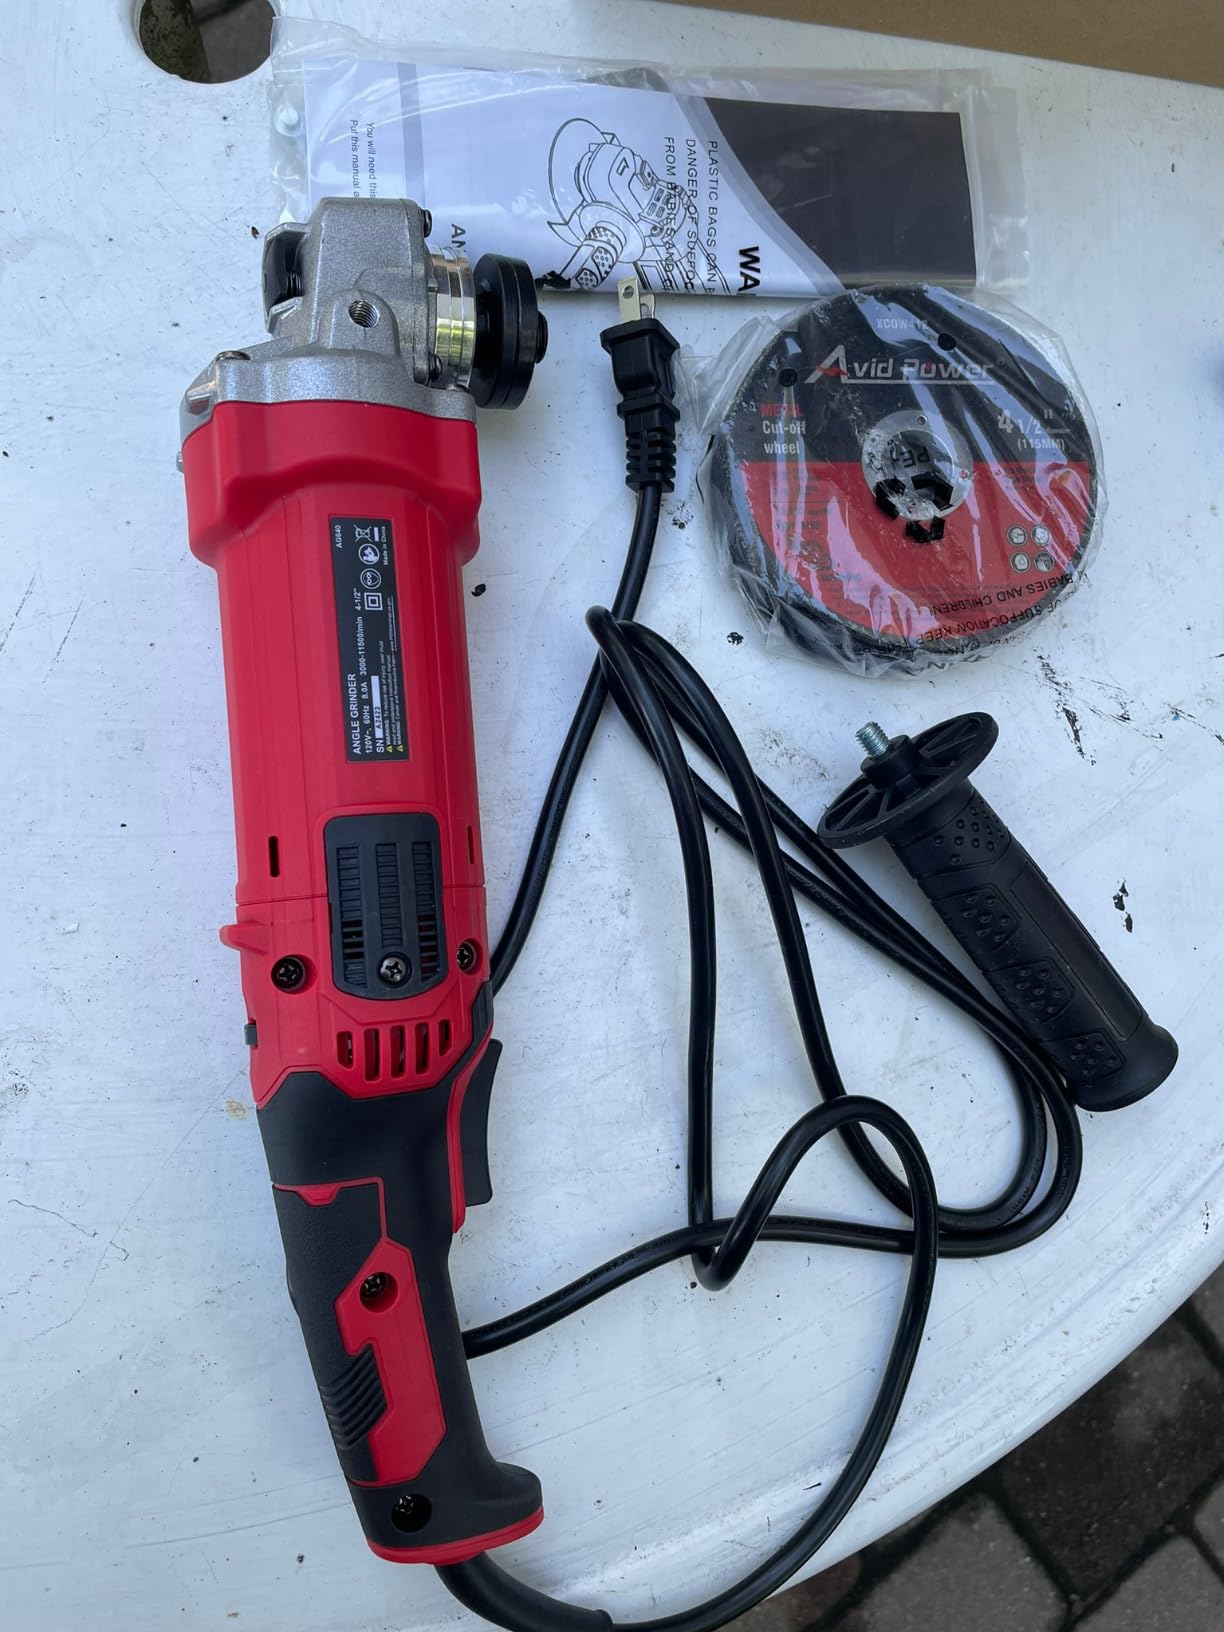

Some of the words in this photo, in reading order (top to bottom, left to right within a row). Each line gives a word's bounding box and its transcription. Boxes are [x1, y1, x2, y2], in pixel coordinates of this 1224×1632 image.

[350, 119, 359, 134] Put
[366, 122, 375, 139] You
[351, 136, 360, 152] this
[367, 140, 377, 155] will
[664, 136, 677, 176] FROM
[352, 154, 361, 188] manual
[368, 156, 377, 181] need
[685, 138, 698, 199] DANGER
[707, 140, 719, 201] PLASTIC
[369, 181, 378, 200] this
[665, 181, 677, 237] BABIES
[687, 204, 698, 224] OF
[706, 206, 718, 248] BAGS
[663, 240, 676, 273] AND
[706, 252, 718, 283] CAN
[804, 344, 894, 384] Avid
[902, 358, 994, 379] Power
[760, 403, 804, 417] METAL
[997, 408, 1014, 433] 4
[762, 420, 806, 436] Cut-off
[763, 439, 800, 455] wheel
[1017, 438, 1066, 451] (115MM)
[334, 524, 343, 548] AG640
[382, 542, 388, 550] in
[996, 585, 1022, 602] AND
[1026, 573, 1074, 595] BABIES
[928, 595, 992, 616] CHILDREN!
[356, 615, 368, 676] 3000-11500/min
[916, 626, 952, 645] KEEP
[347, 673, 359, 718] GRINDER
[360, 681, 369, 700] 8.0A
[362, 704, 371, 725] 60Hz
[350, 720, 362, 755] ANGLE
[375, 739, 385, 753] SN
